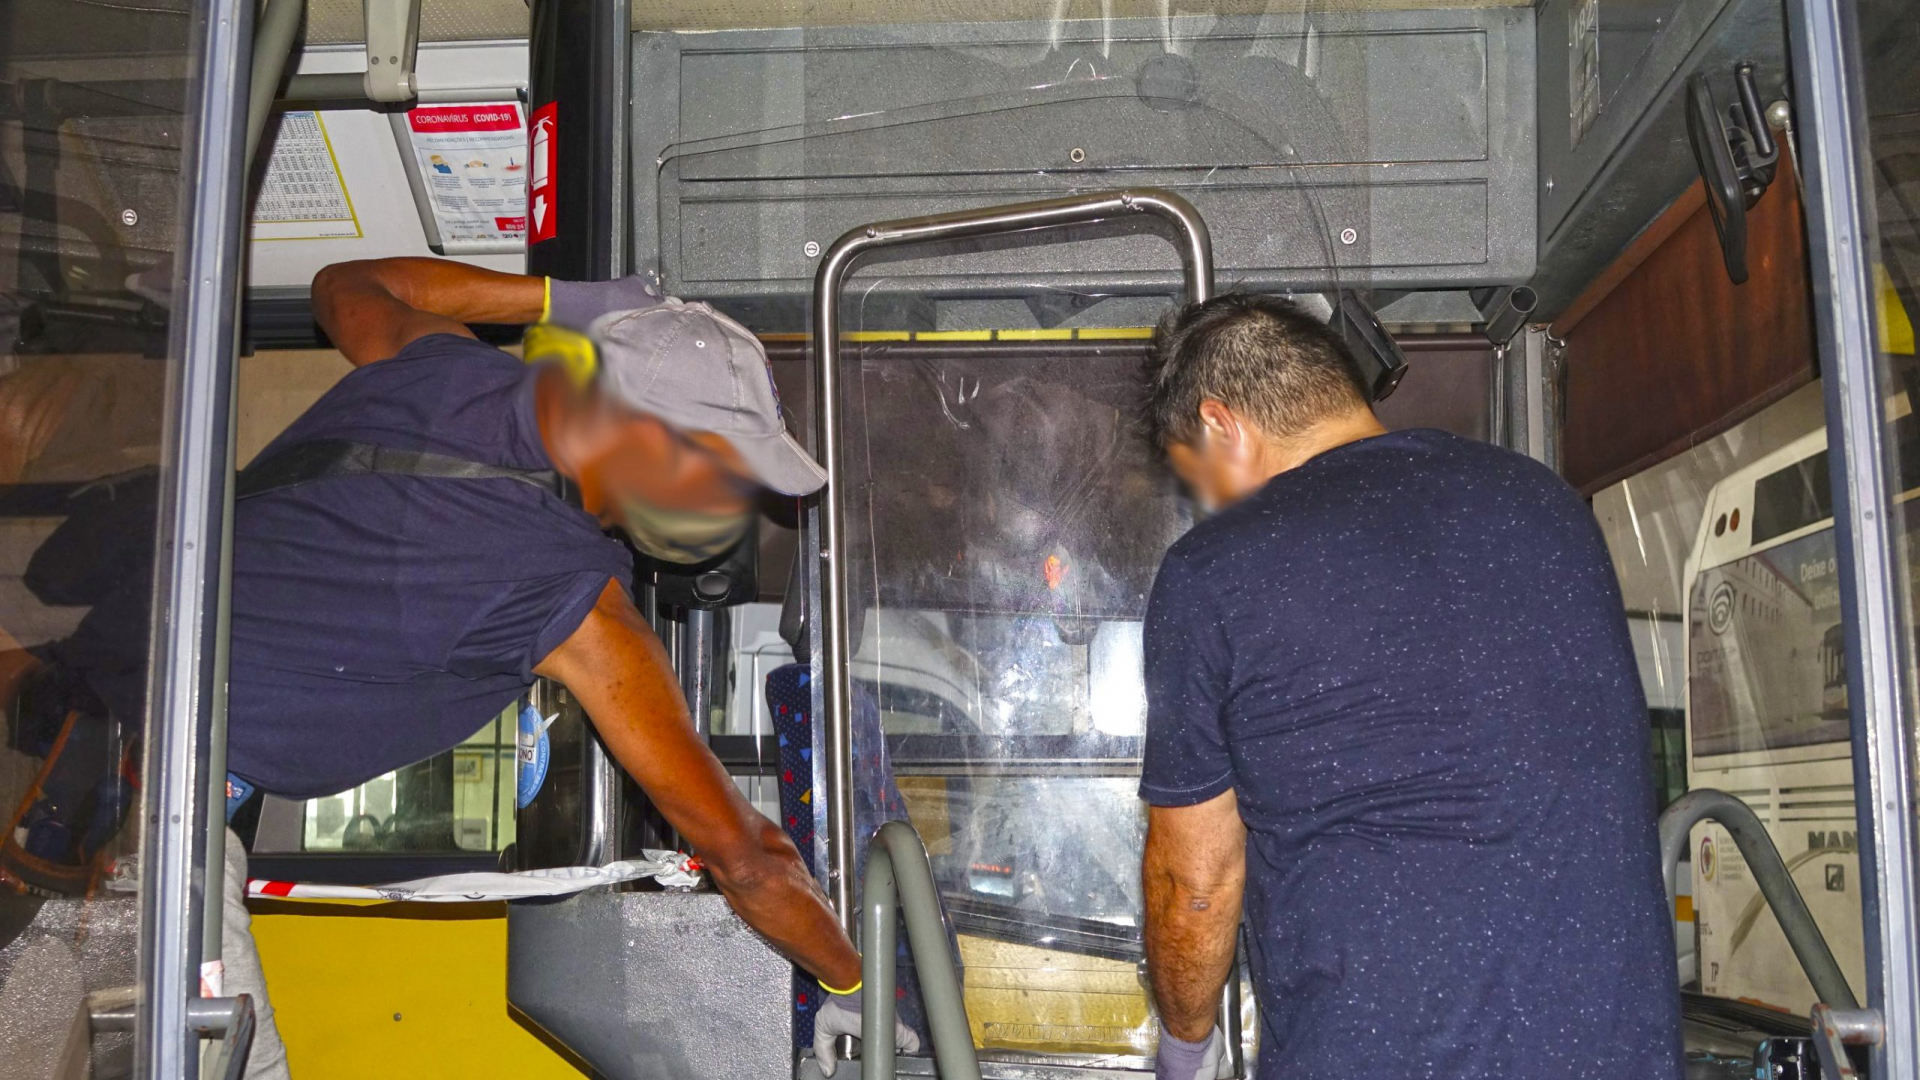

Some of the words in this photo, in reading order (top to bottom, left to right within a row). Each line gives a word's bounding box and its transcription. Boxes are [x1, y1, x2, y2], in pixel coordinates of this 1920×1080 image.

[416, 112, 468, 124] CORONAVÍRUS
[473, 112, 512, 123] (COVID-19)
[1800, 558, 1827, 582] Deixe
[1808, 831, 1859, 854] MAN
